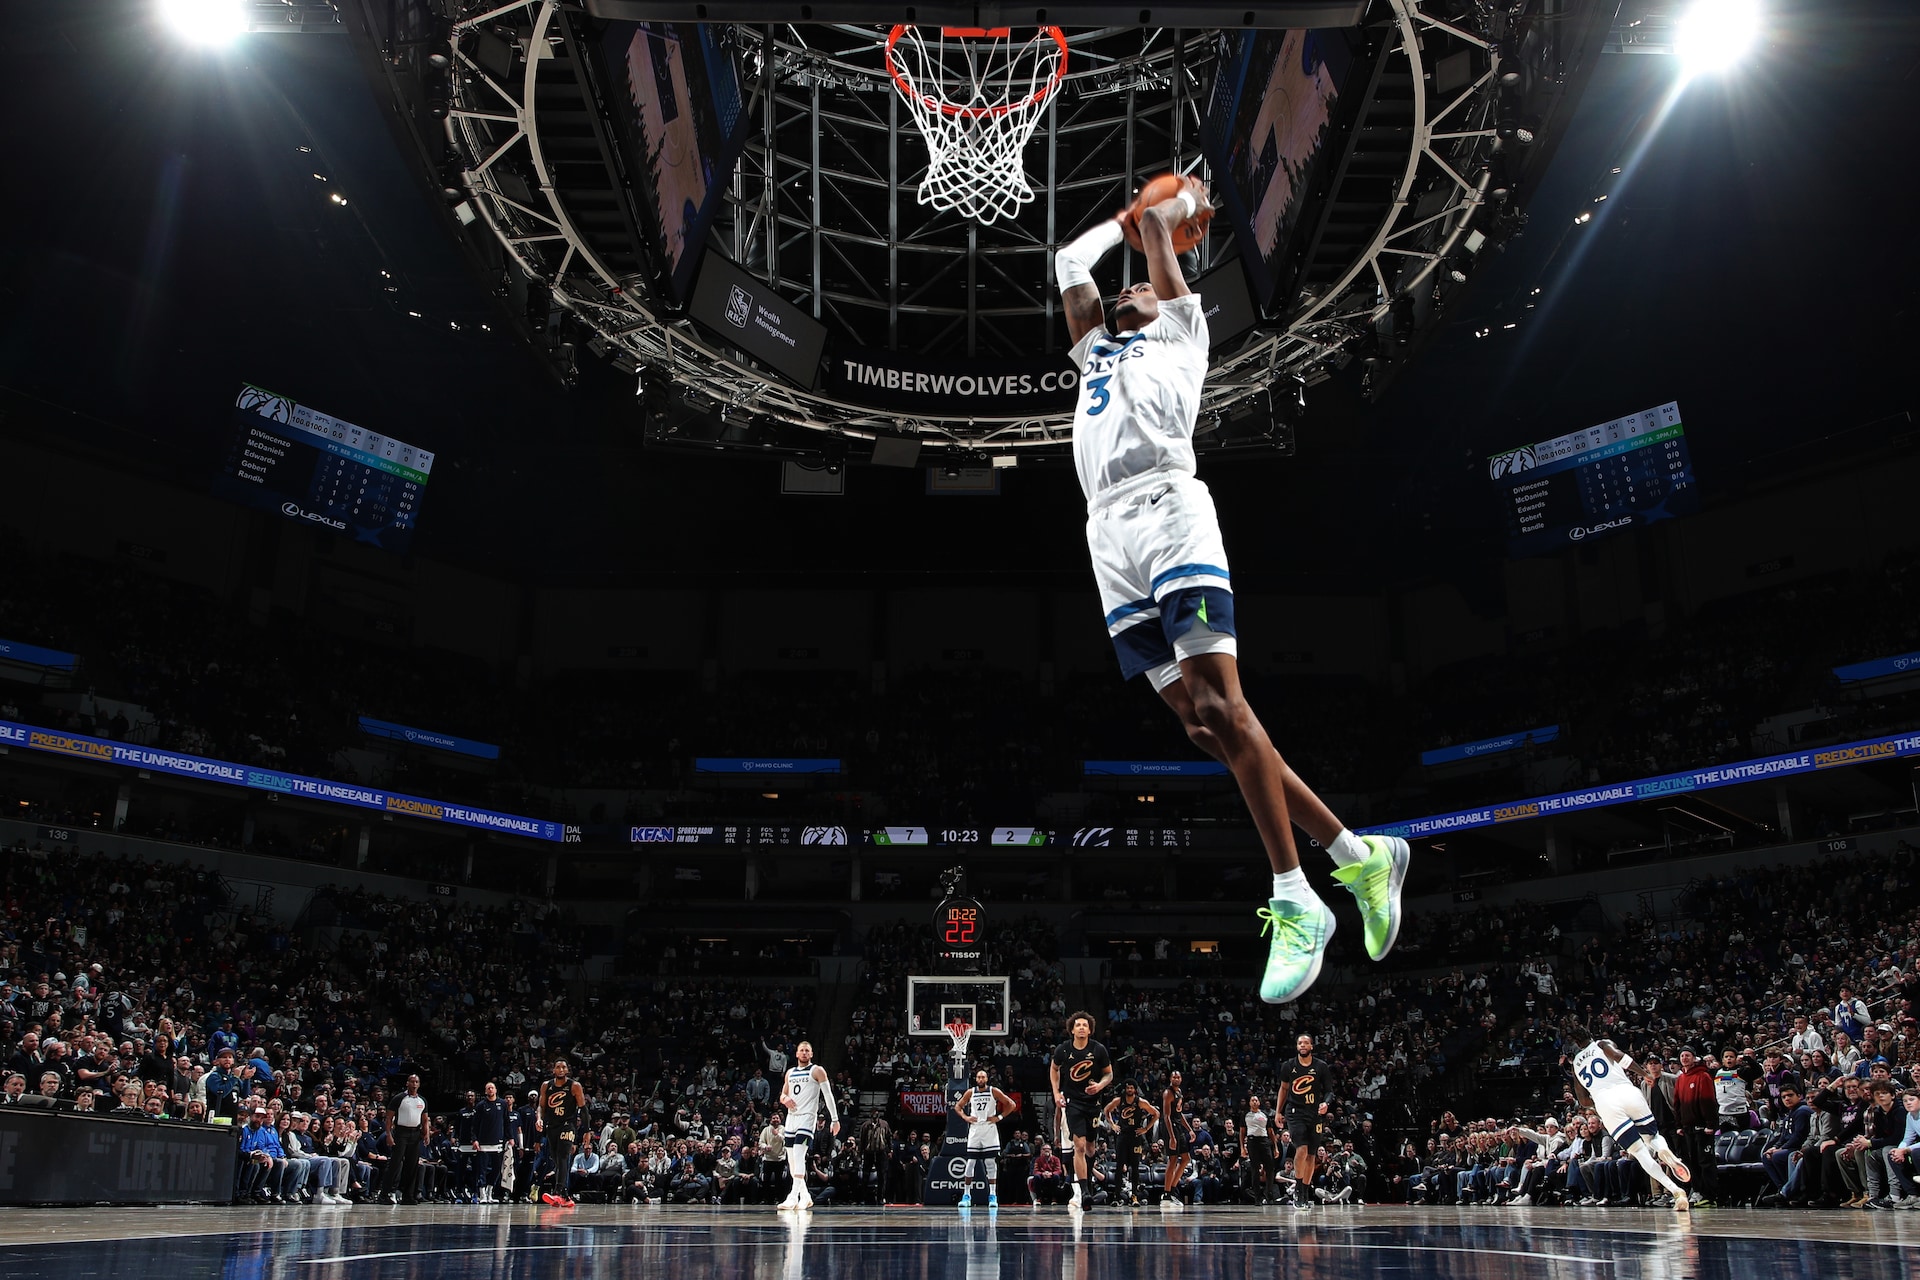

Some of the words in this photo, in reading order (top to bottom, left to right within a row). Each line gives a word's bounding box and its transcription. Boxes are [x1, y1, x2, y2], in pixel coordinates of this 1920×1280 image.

[728, 310, 744, 325] RBC
[758, 304, 781, 325] Wealth
[755, 316, 796, 346] Management
[1082, 346, 1144, 377] OLVES
[844, 360, 1078, 396] TIMBERWOLVES.CO
[1086, 375, 1112, 416] 3
[250, 428, 291, 448] DiVincenzo
[247, 439, 284, 456] McDaniels
[244, 449, 276, 465] Edwards
[242, 460, 267, 473] Gobert
[238, 470, 264, 484] Randle
[1513, 480, 1549, 494] DiVincenzo
[1515, 490, 1548, 504] McDaniels
[1518, 501, 1546, 514] Edwards
[300, 510, 346, 530] LEXUS
[1520, 512, 1542, 523] Gobert
[1522, 522, 1544, 534] Randle
[1586, 516, 1632, 534] LEXUS
[130, 544, 152, 558] 237
[418, 734, 435, 742] MAYO
[435, 738, 454, 746] CLINIC
[1493, 739, 1513, 748] CLINIC
[30, 732, 113, 757] PREDICTING
[114, 747, 142, 762] THE
[142, 752, 244, 780] UNPREDICTABLE
[248, 772, 292, 789] SEEING
[293, 780, 316, 793] THE
[318, 784, 382, 805] UNSEEABLE
[386, 797, 443, 816] IMAGINING
[444, 808, 464, 819] THE
[465, 811, 538, 833] UNIMAGINABLE
[1410, 821, 1430, 833] THE
[1431, 811, 1491, 830] UNCURABLE
[1494, 803, 1538, 819] SOLVING
[1538, 799, 1561, 811] THE
[1562, 786, 1633, 808] UNSOLVABLE
[1636, 775, 1694, 795] TREATING
[1694, 772, 1719, 784] THE
[1721, 755, 1810, 780] UNTREATABLE
[1814, 741, 1895, 764] PREDICTING
[1894, 737, 1920, 750] THE
[48, 829, 68, 840] 136
[631, 827, 674, 842] KFAN
[906, 830, 913, 840] 7
[941, 830, 978, 842] 10:23
[1006, 831, 1014, 842] 2
[1827, 841, 1847, 851] 106
[435, 886, 450, 895] 138
[1461, 892, 1474, 901] 104
[949, 909, 976, 920] 10:22
[946, 921, 974, 942] 22
[106, 1007, 115, 1018] 5
[1578, 1058, 1609, 1088] 30
[794, 1084, 801, 1095] 0
[904, 1094, 942, 1104] PROTEIN
[1305, 1093, 1315, 1104] 10
[554, 1107, 565, 1117] 45
[912, 1104, 930, 1113] THE
[118, 1138, 218, 1191] LIFETIME
